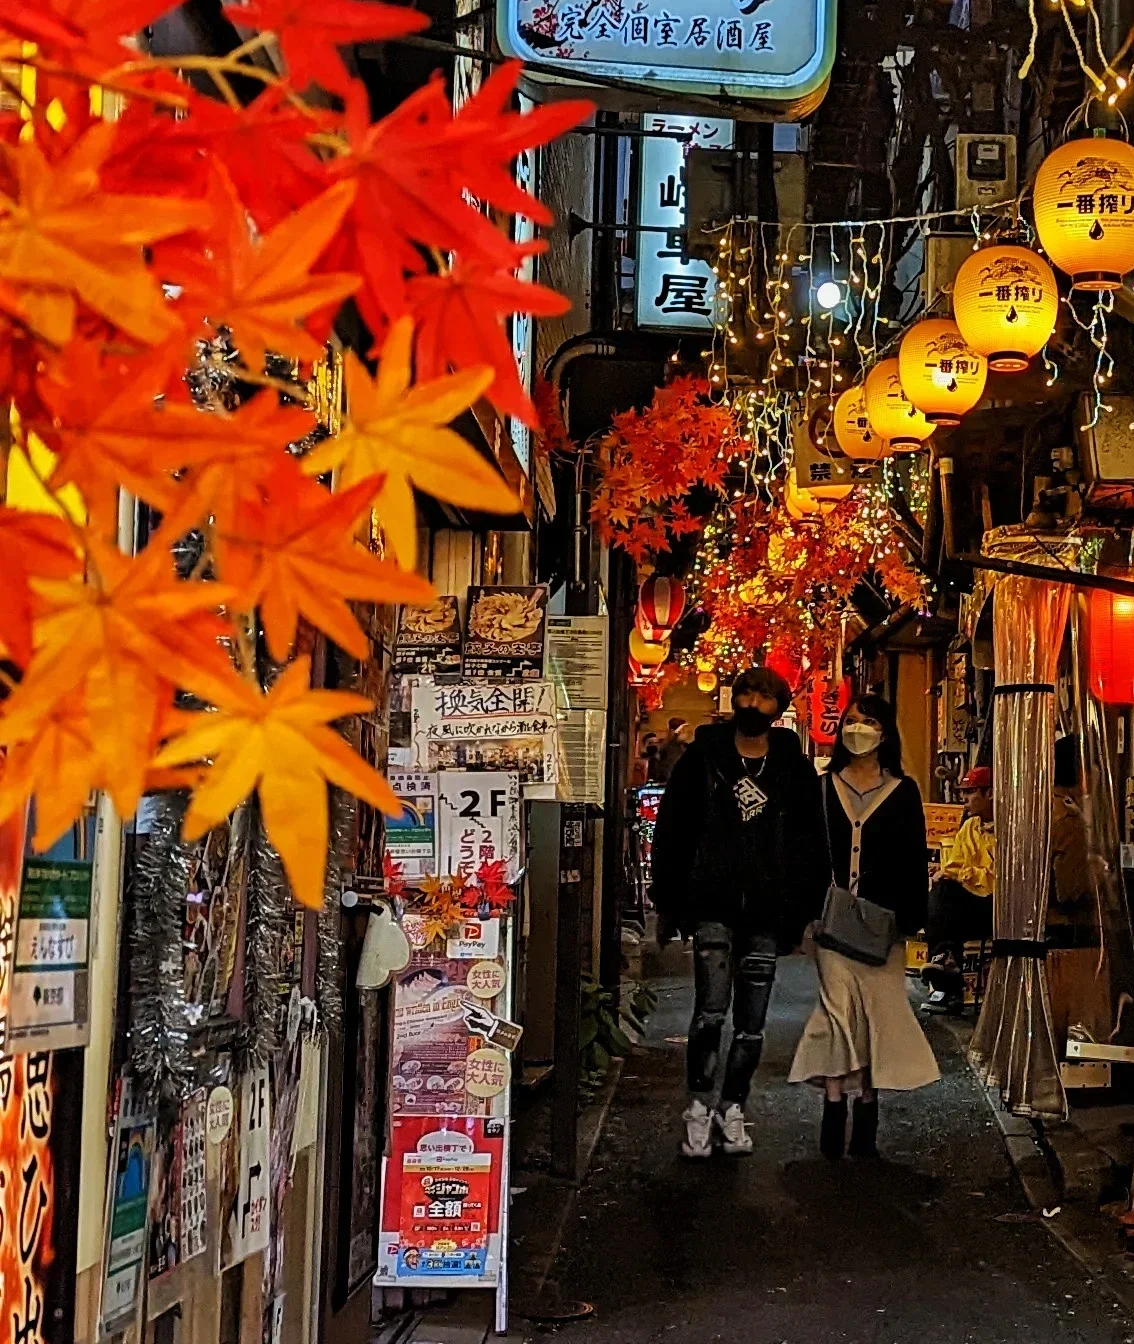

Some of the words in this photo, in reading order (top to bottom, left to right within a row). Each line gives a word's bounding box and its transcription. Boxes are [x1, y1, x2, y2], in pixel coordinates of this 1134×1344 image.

[557, 7, 775, 54] 完全個室居酒屋
[652, 119, 718, 139] ラーメン
[979, 285, 1044, 303] 一番搾り
[925, 359, 980, 376] 一番搾り
[459, 789, 506, 817] 2F
[459, 940, 486, 949] PayPay
[472, 970, 500, 979] 女性に
[472, 979, 501, 989] 大人気
[468, 1058, 504, 1073] 女性に
[467, 1073, 504, 1087] 大人気
[249, 1078, 265, 1131] 2F
[428, 1201, 462, 1218] 全額
